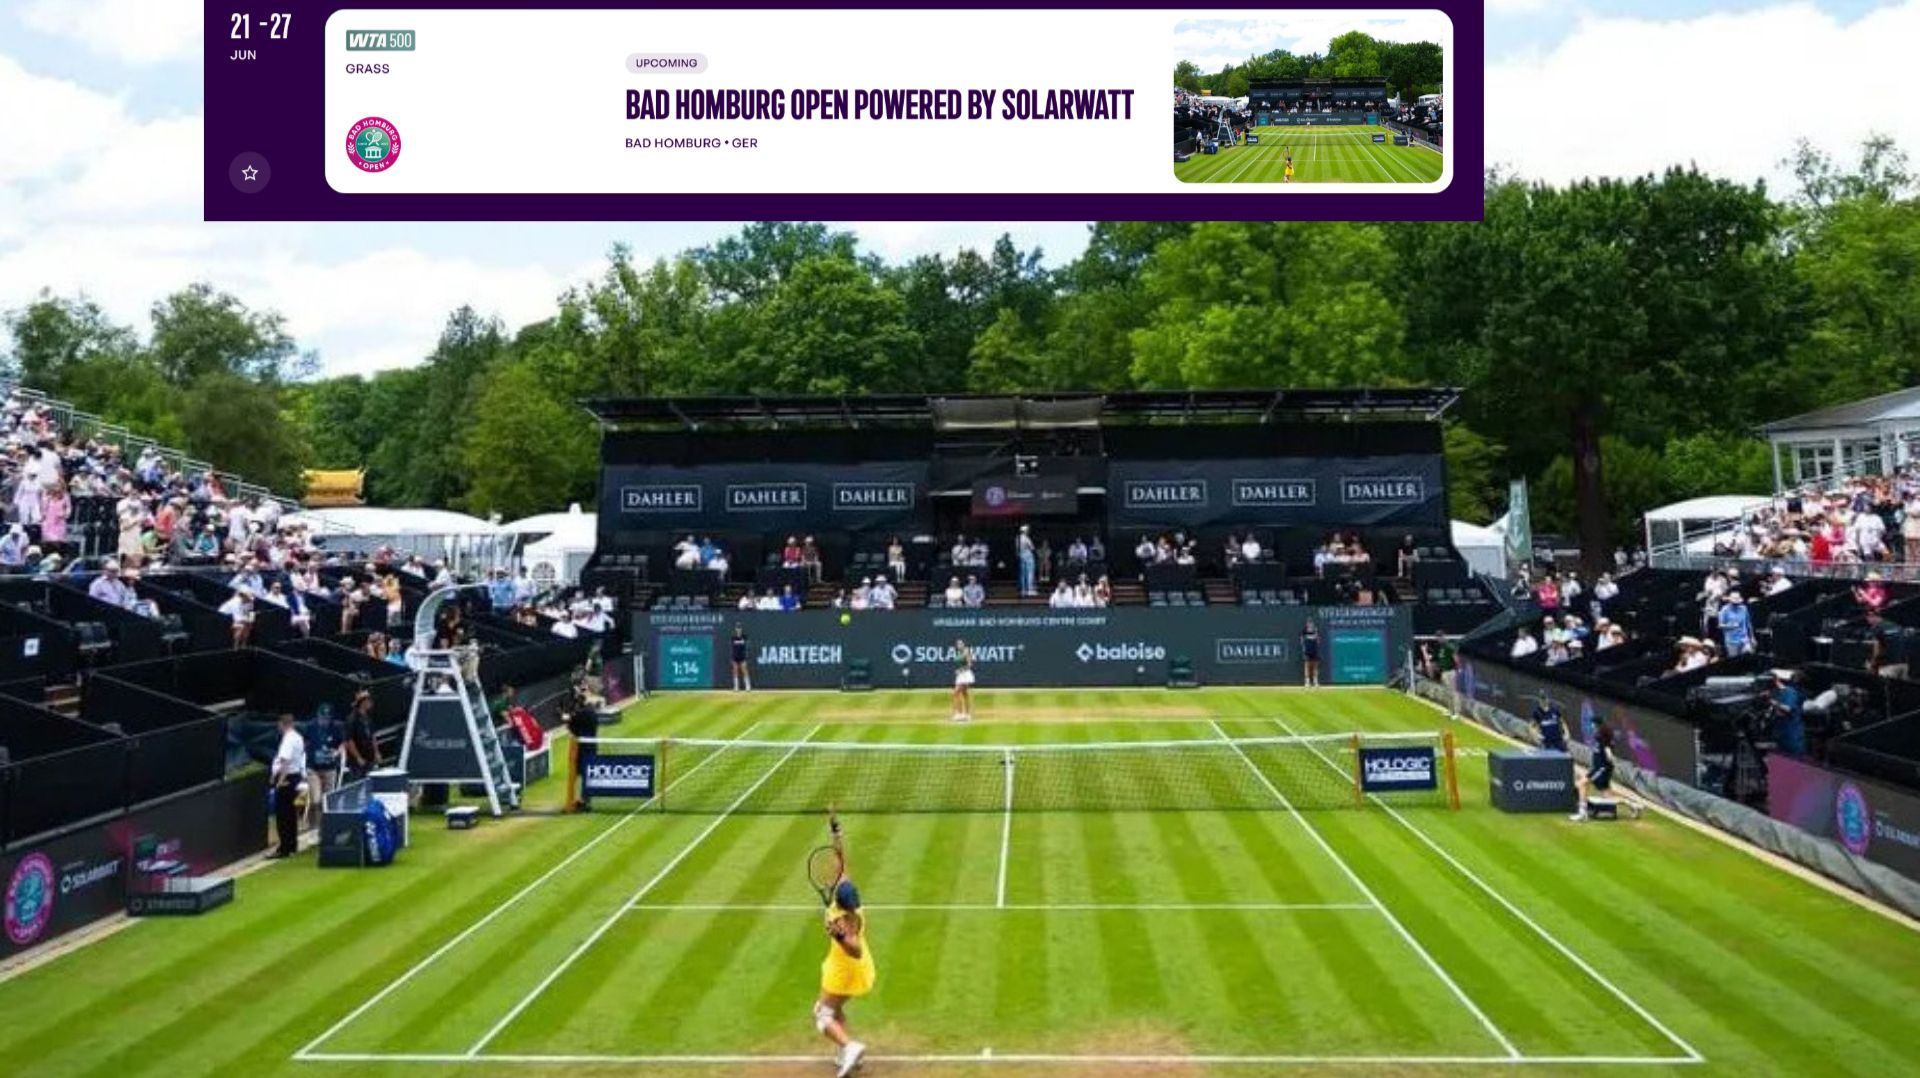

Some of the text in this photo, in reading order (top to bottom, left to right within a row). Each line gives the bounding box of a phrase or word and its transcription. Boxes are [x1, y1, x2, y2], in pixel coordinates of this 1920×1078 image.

[734, 489, 801, 505] DAHLER
[840, 488, 908, 503] DAHLER
[1132, 486, 1200, 502] DAHLER
[1240, 485, 1309, 500] DAHLER
[1349, 482, 1418, 498] DAHLER
[628, 491, 695, 507] DAHLER
[757, 645, 842, 664] JARLTECH
[915, 645, 1017, 662] SOLAWATT
[1095, 641, 1166, 661] baloise
[1222, 644, 1283, 658] DAHLER
[586, 764, 651, 779] HOLOGIC
[1364, 757, 1431, 773] HOLOGIC
